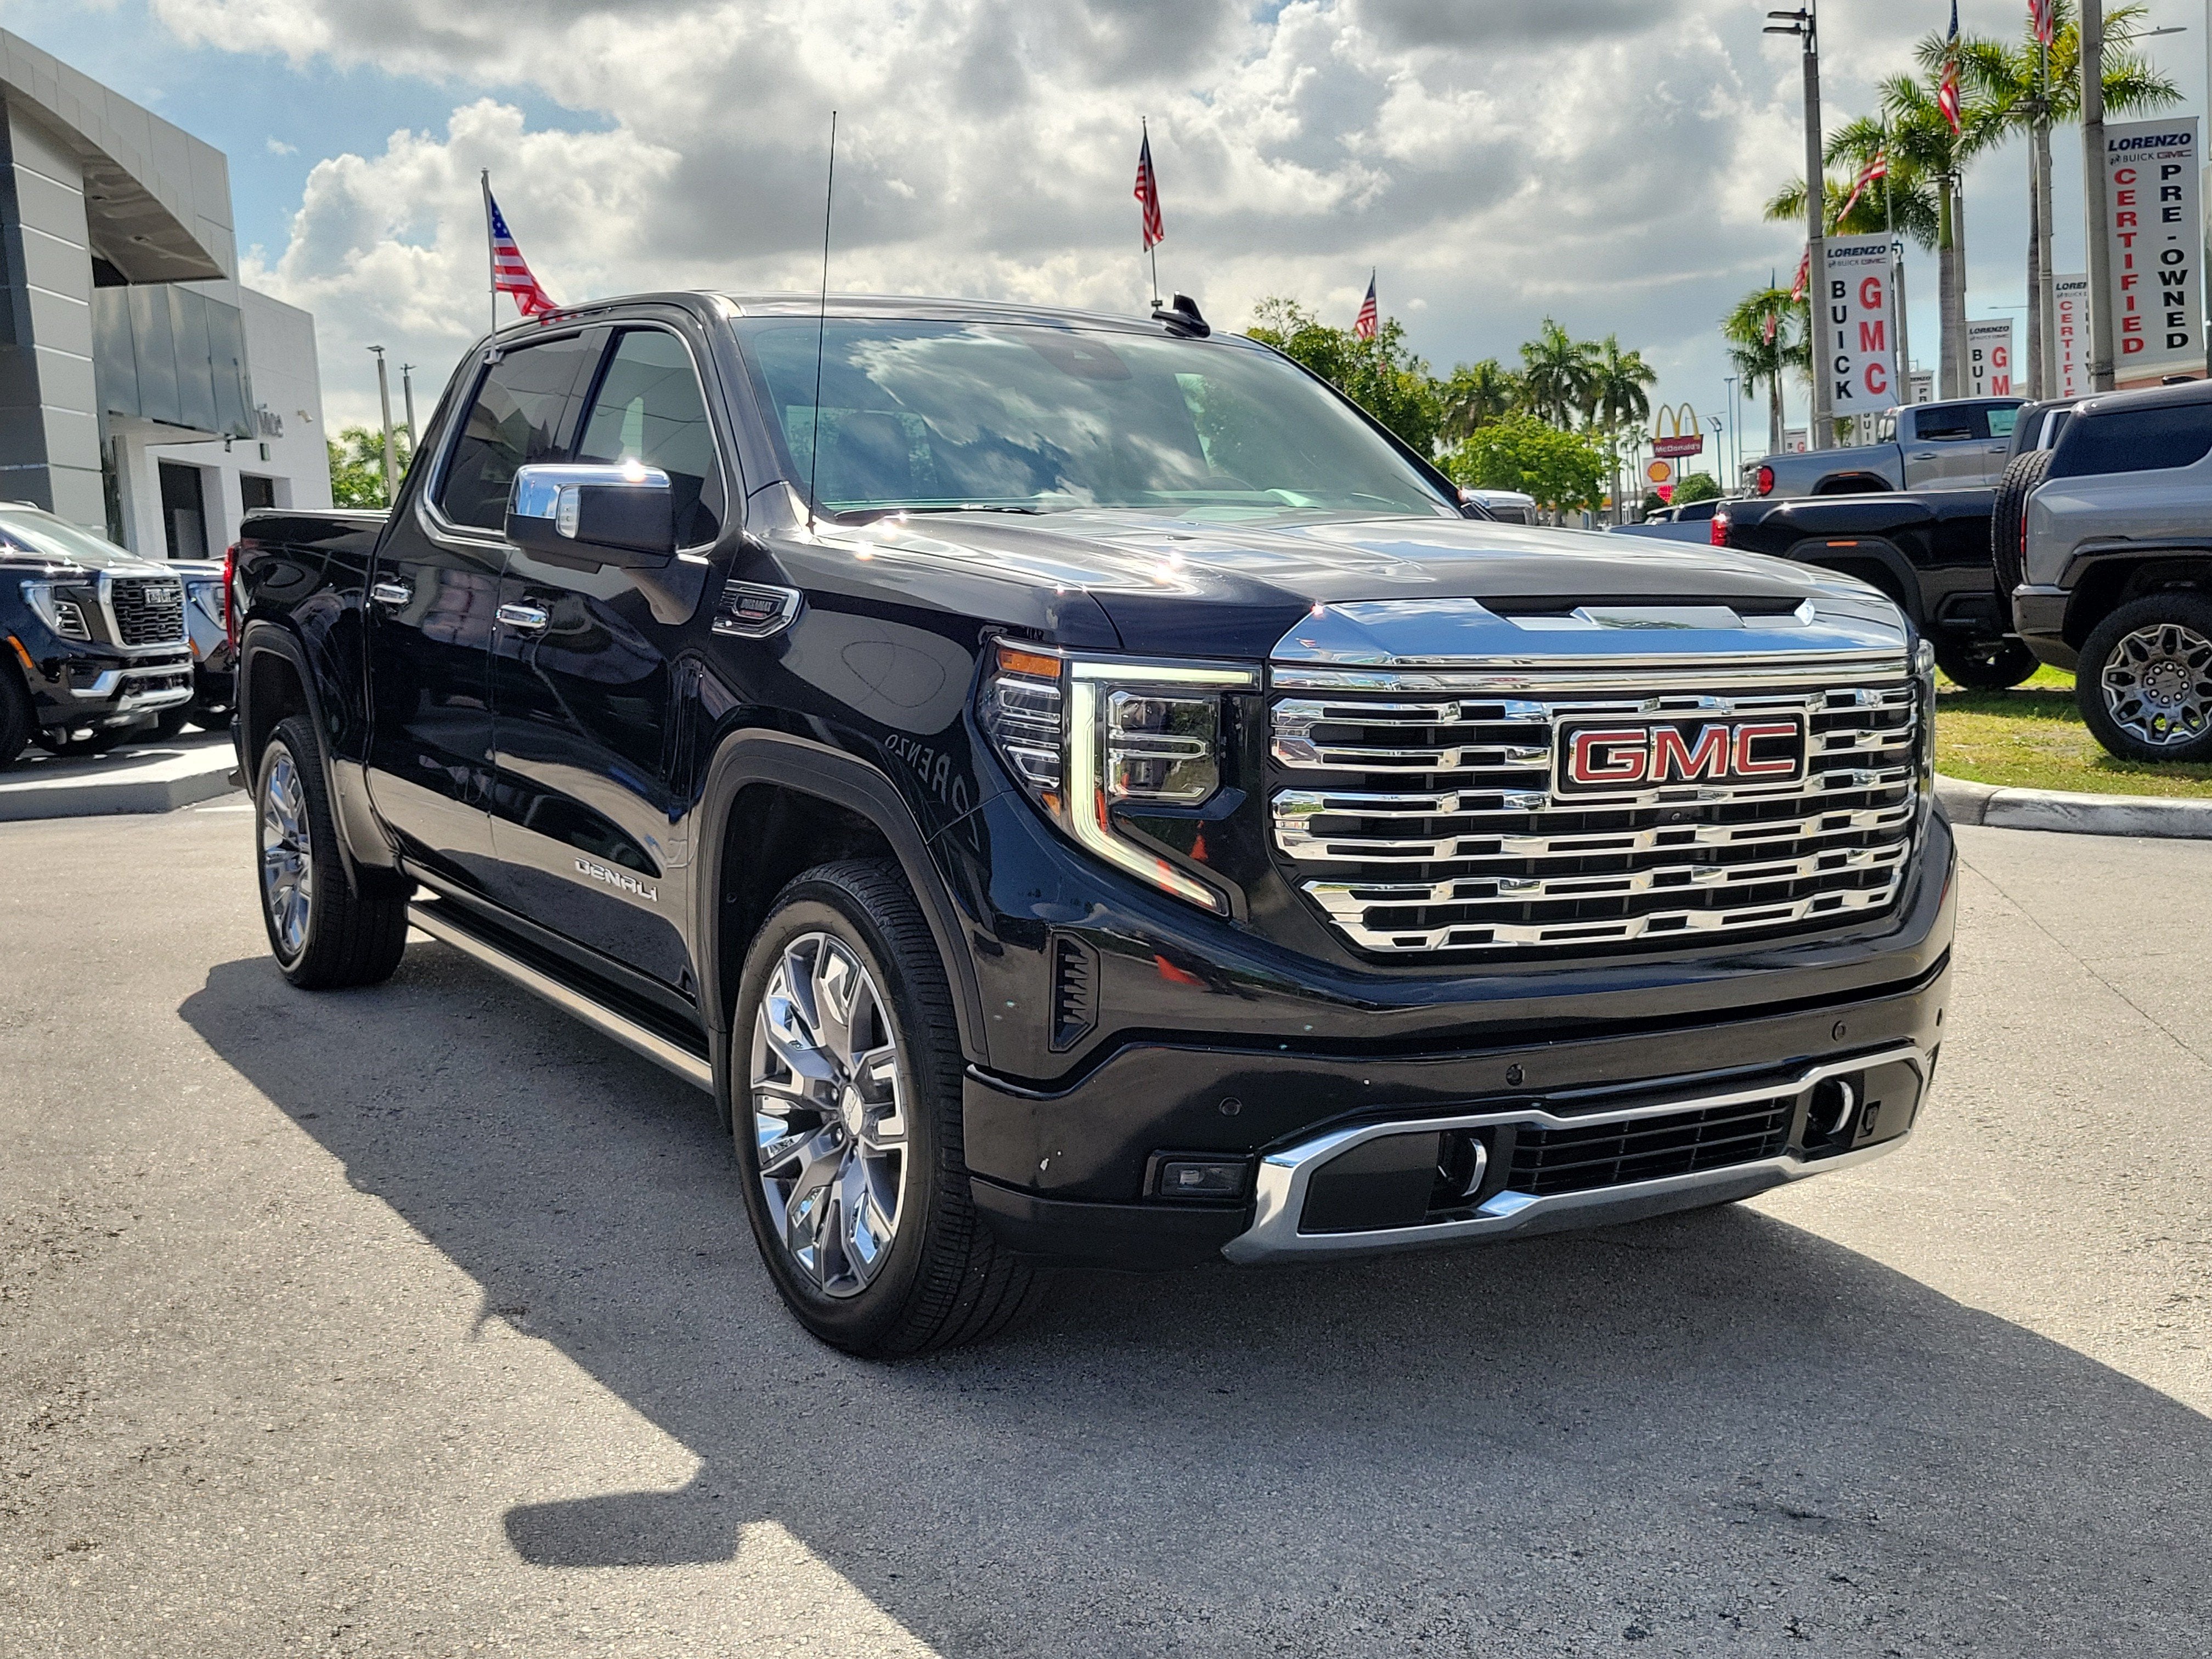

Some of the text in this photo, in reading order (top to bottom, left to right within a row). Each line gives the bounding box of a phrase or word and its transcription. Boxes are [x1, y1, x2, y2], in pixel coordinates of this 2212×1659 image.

[2108, 133, 2192, 151] LORENZO
[2123, 149, 2192, 163] BUICK GMC
[1827, 245, 1886, 258] LORENZO
[2114, 168, 2145, 354] CERTIFIED
[1831, 280, 1853, 399] BUICK
[1859, 276, 1887, 395] GMC
[1655, 443, 1701, 453] McDonald's
[1568, 723, 1798, 784] GMC
[575, 857, 658, 902] DENALI
